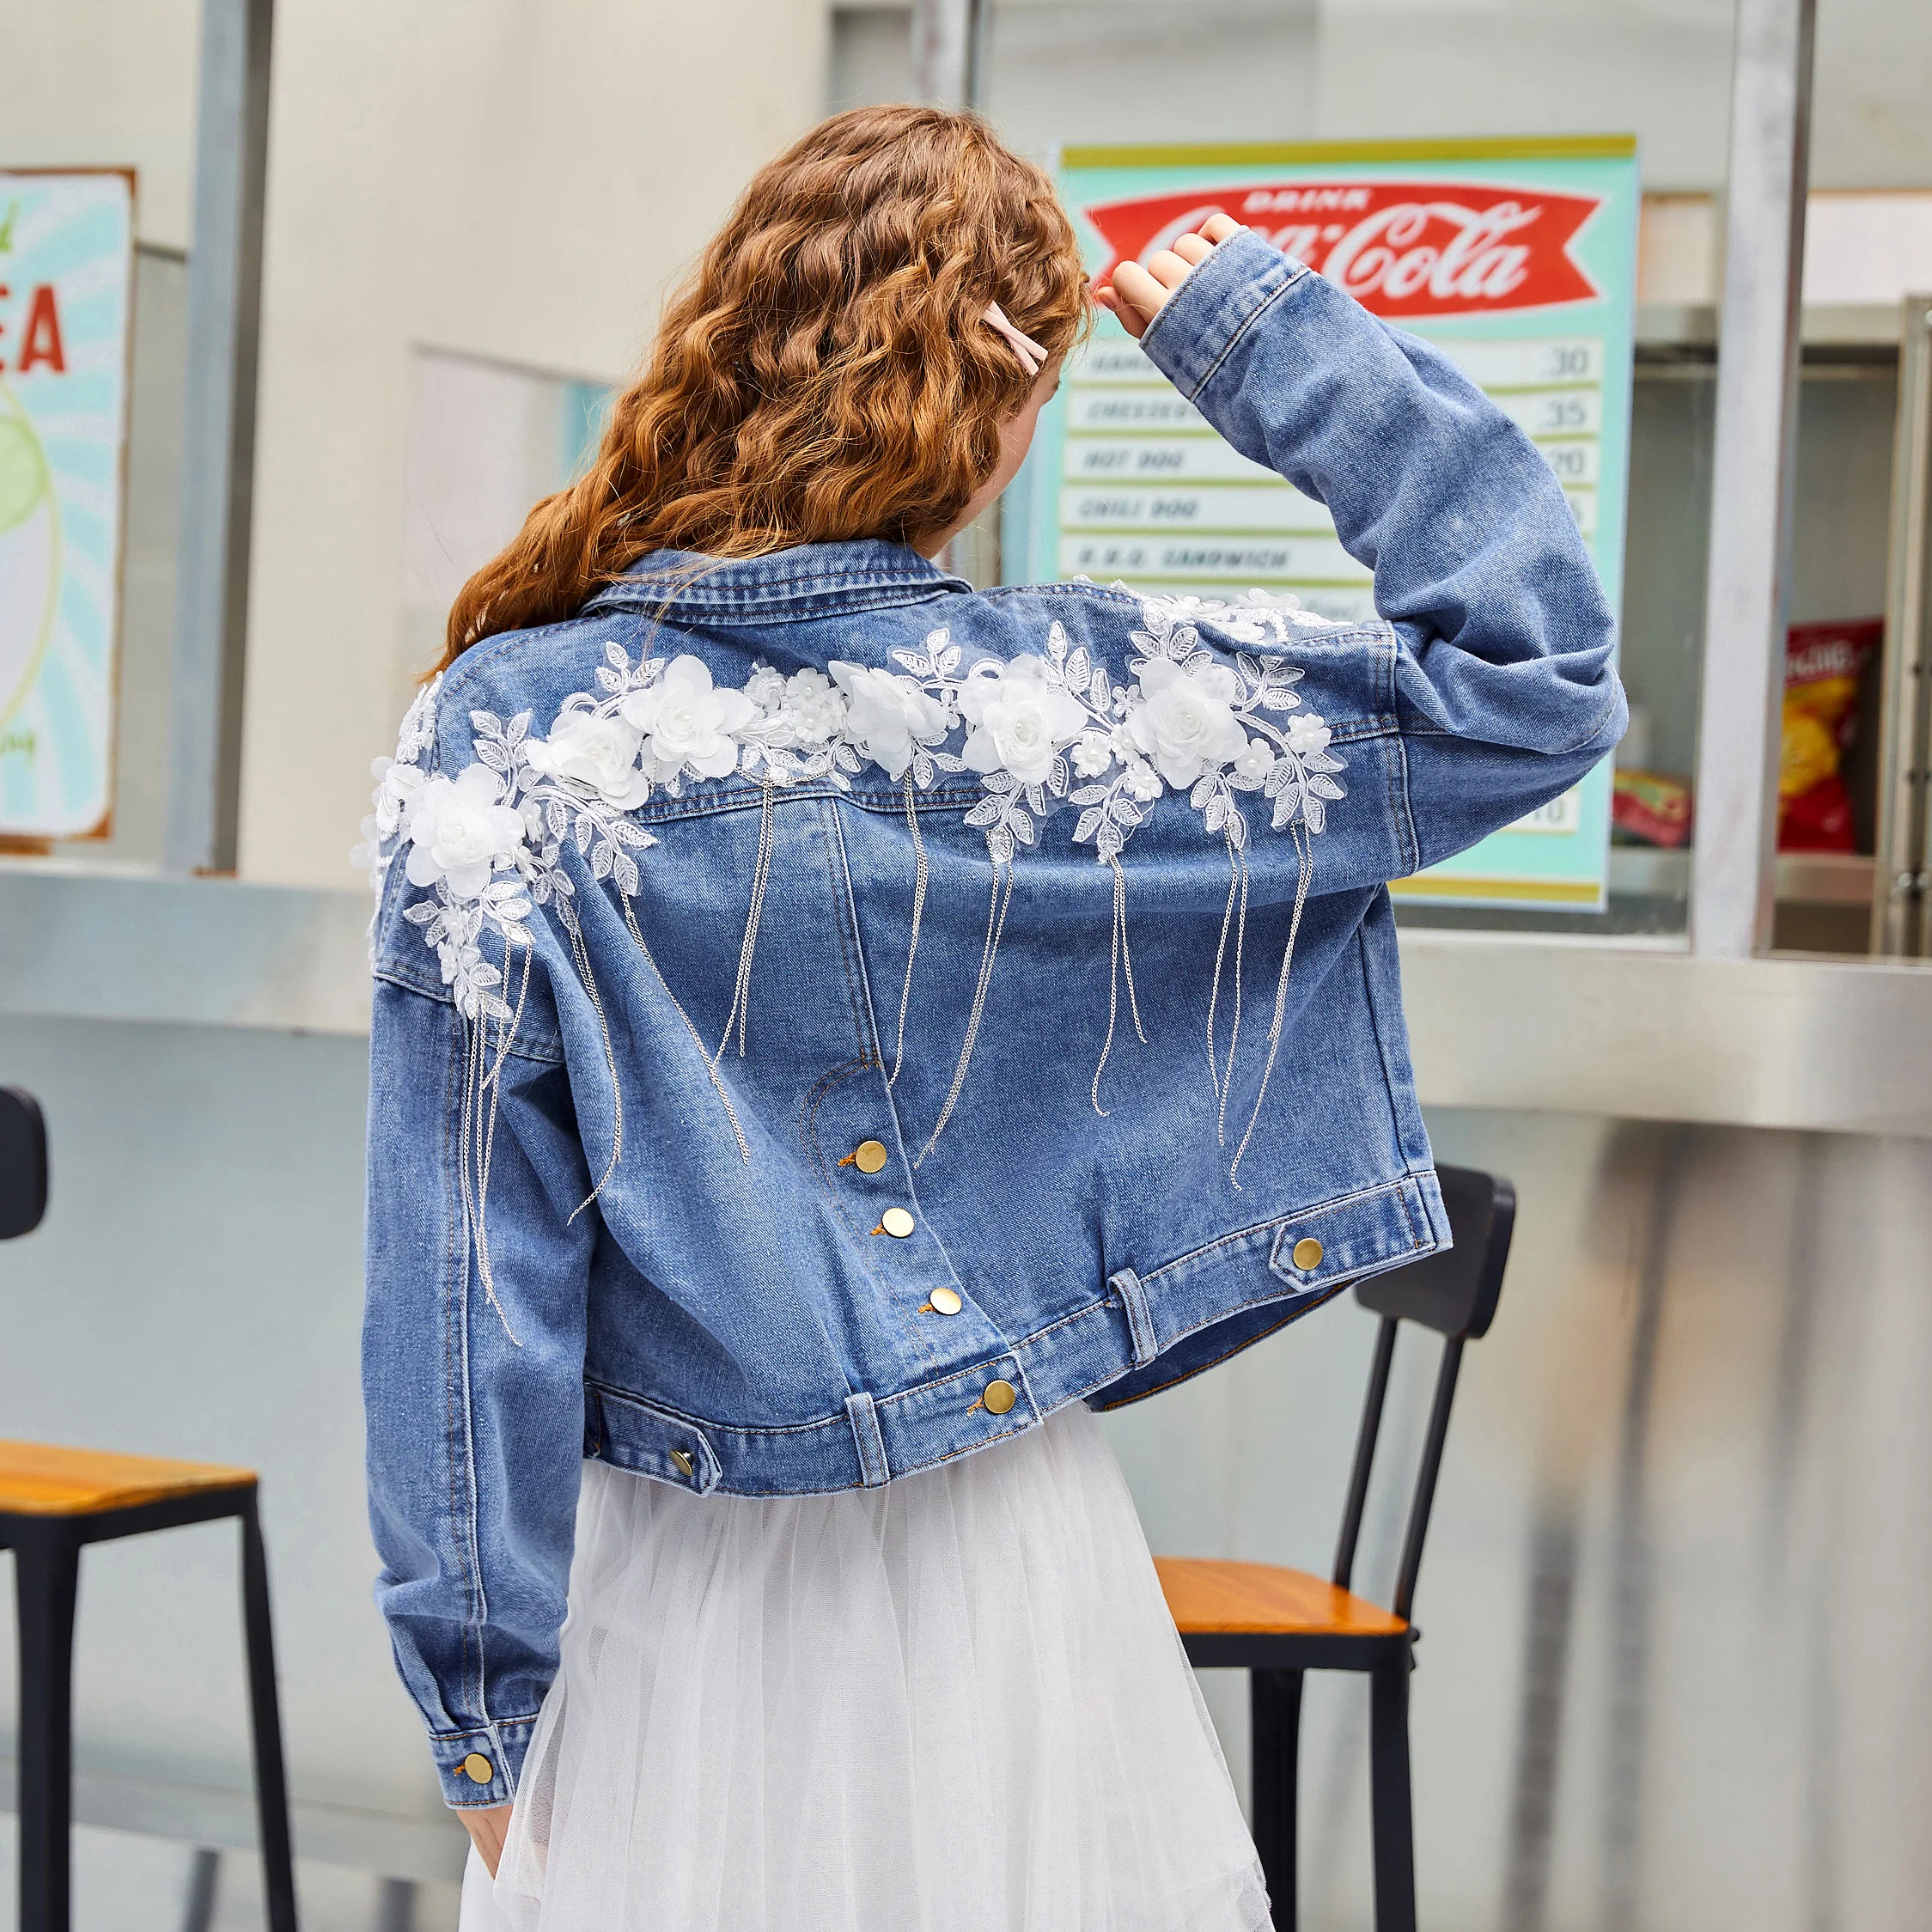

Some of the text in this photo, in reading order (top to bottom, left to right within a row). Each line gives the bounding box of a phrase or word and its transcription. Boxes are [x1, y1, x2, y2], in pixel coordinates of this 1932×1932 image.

[1243, 189, 1372, 212] DRINK
[1137, 198, 1543, 300] a-Cola
[0, 283, 67, 373] A
[1084, 448, 1185, 470] HOT DOG
[1079, 497, 1199, 519] CHILI DOG
[1161, 545, 1289, 568] SANDWICH
